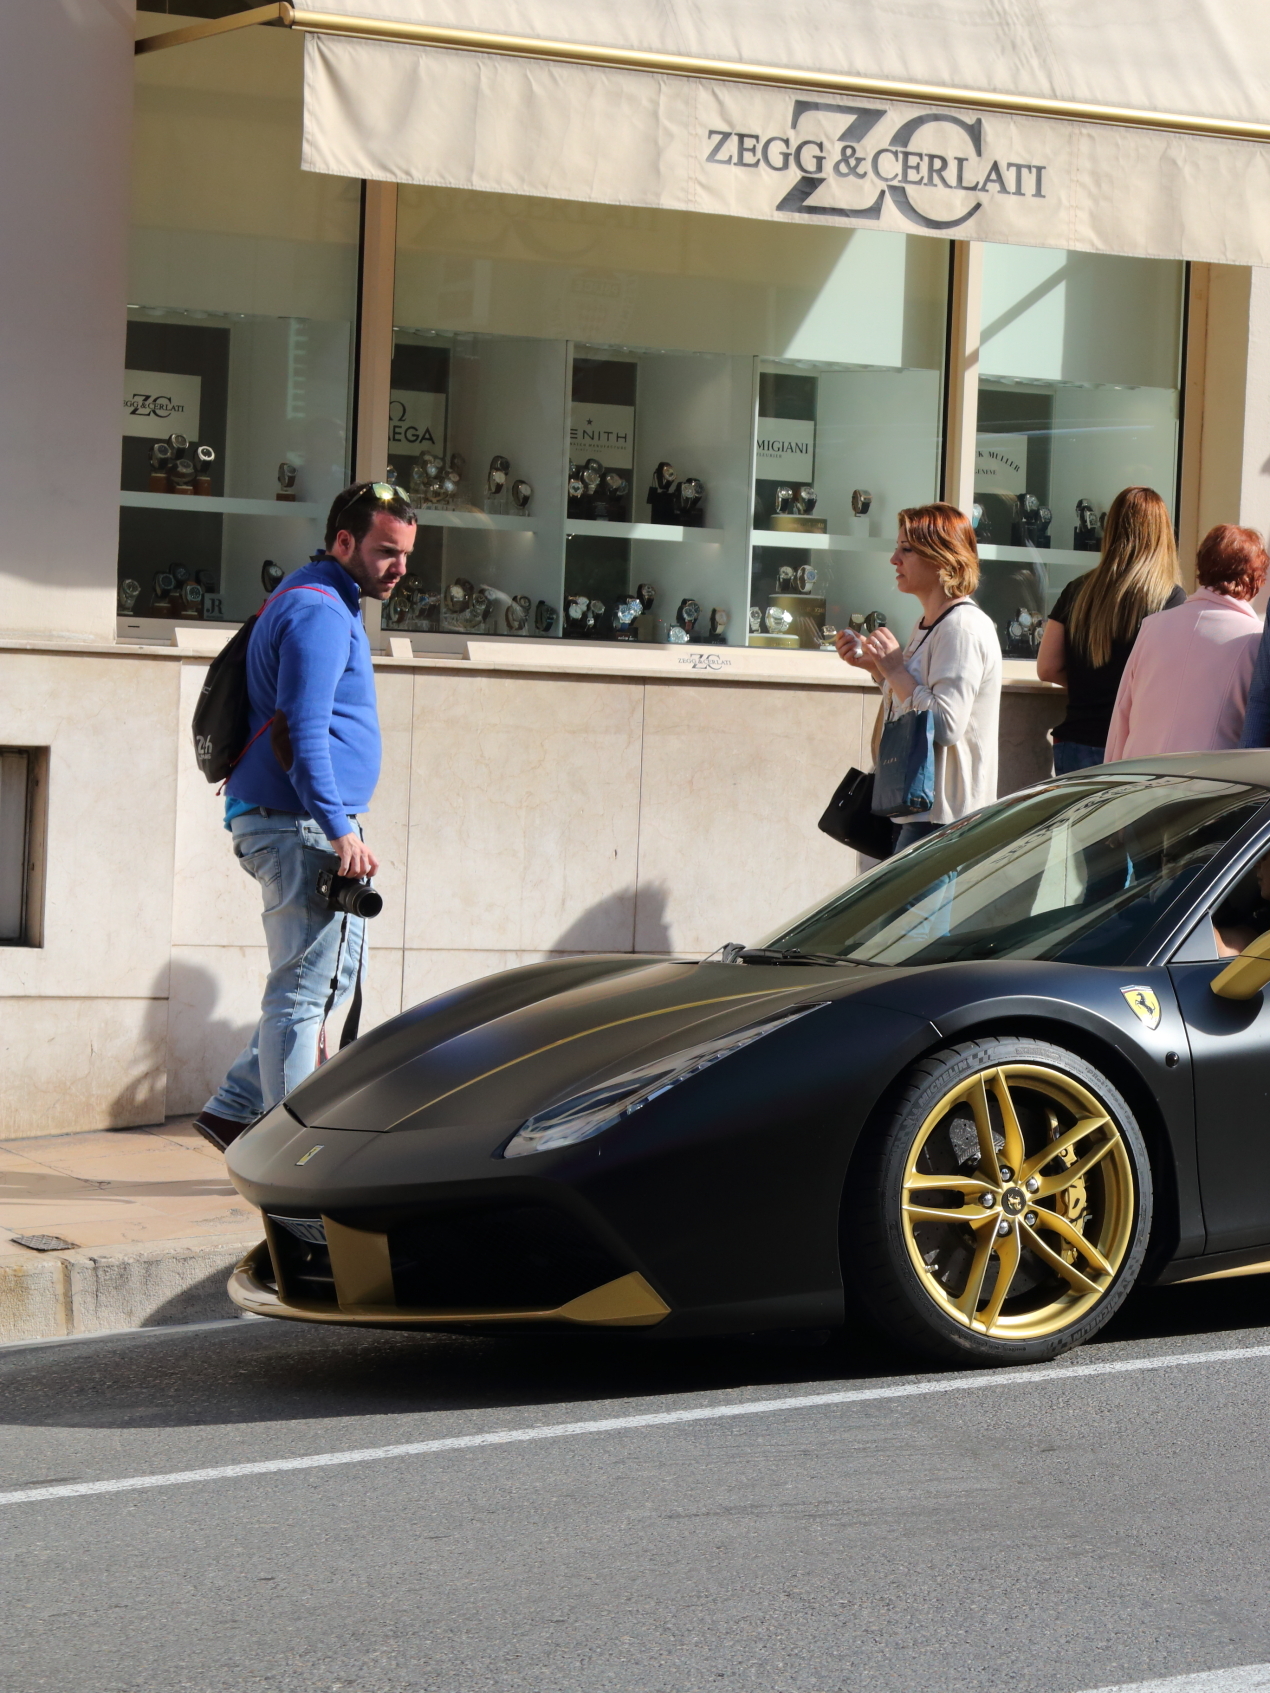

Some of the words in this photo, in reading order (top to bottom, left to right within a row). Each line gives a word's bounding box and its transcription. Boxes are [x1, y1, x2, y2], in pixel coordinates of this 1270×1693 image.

[705, 129, 827, 175] ZEGG
[870, 147, 1047, 199] CERLATI
[147, 402, 185, 413] CERLATI
[389, 425, 435, 444] EGA
[988, 450, 1020, 473] MULLER
[917, 1059, 968, 1107] MICHELIN
[1073, 1294, 1119, 1341] MICHELIN
